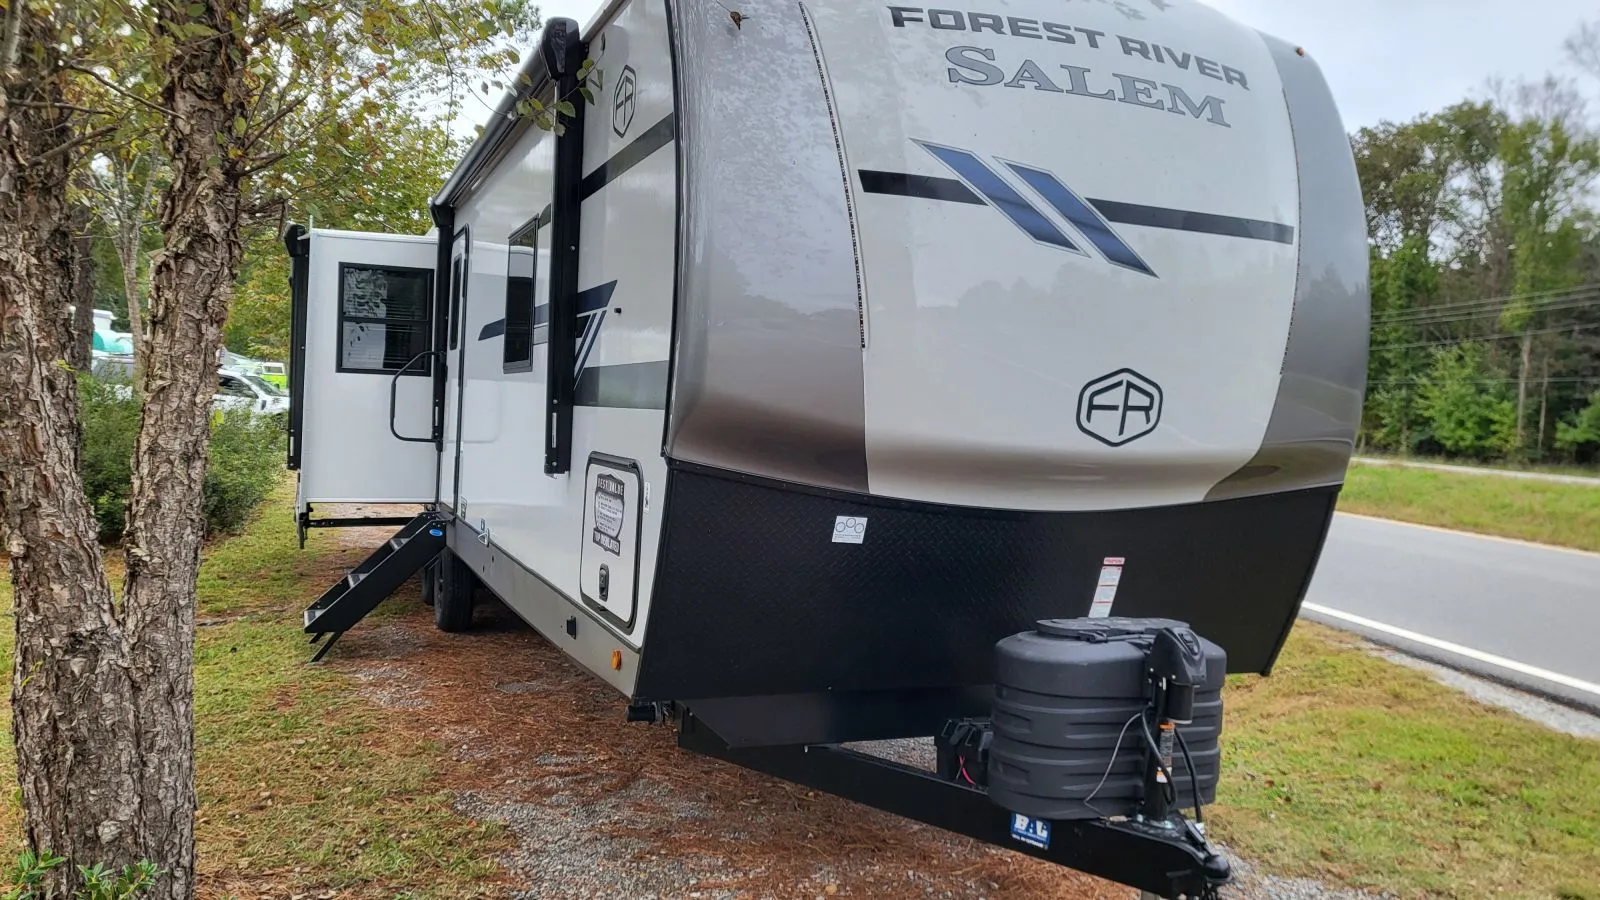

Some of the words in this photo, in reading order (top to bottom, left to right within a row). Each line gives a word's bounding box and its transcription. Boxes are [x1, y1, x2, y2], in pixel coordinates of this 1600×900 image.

[887, 5, 1104, 49] FOREST
[1116, 34, 1250, 91] RIVER
[945, 45, 1231, 128] SALEM
